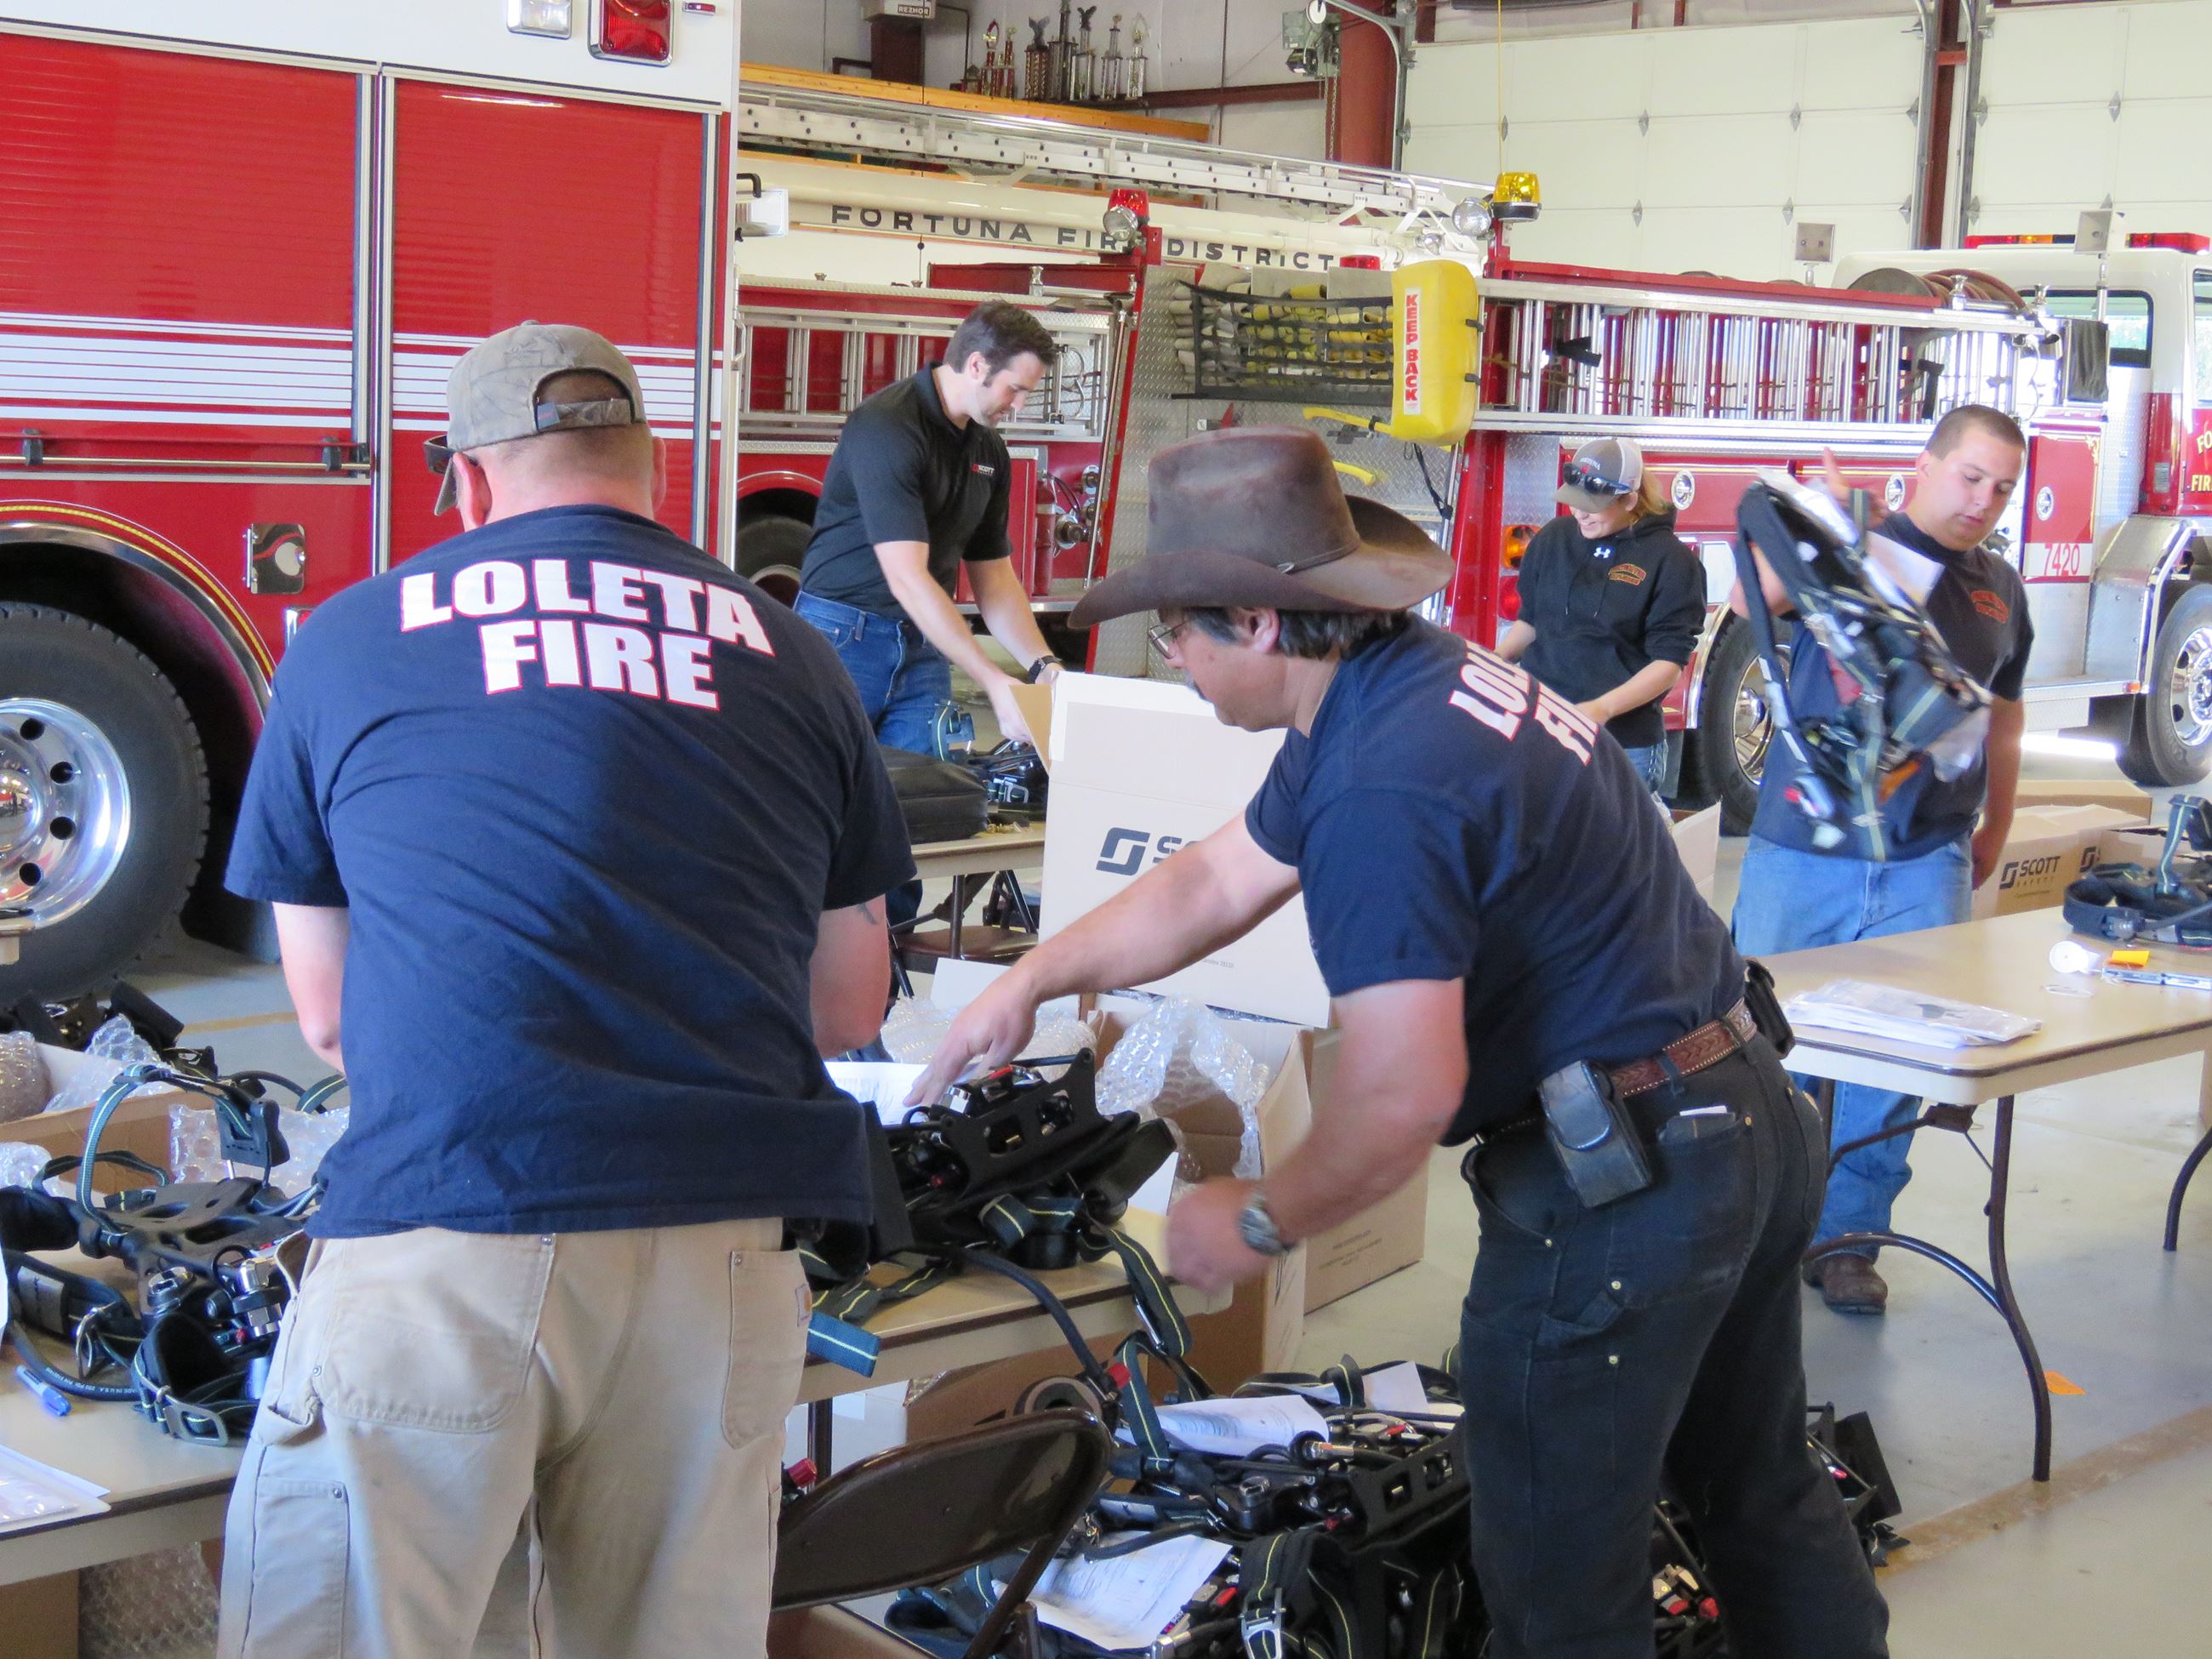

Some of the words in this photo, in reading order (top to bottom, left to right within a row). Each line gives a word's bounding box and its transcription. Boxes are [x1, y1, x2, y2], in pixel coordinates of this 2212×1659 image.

[831, 204, 1032, 242] FORTUNA
[1057, 226, 1118, 250] FIR
[1166, 238, 1334, 271] DISTRICT
[1405, 294, 1418, 345] KEEP
[1405, 349, 1419, 402] BACK
[2191, 474, 2212, 492] FIR
[2044, 543, 2080, 578] 7420
[401, 559, 775, 656] LOLETA
[478, 619, 721, 710] FIRE
[2019, 856, 2061, 877] SCOTT
